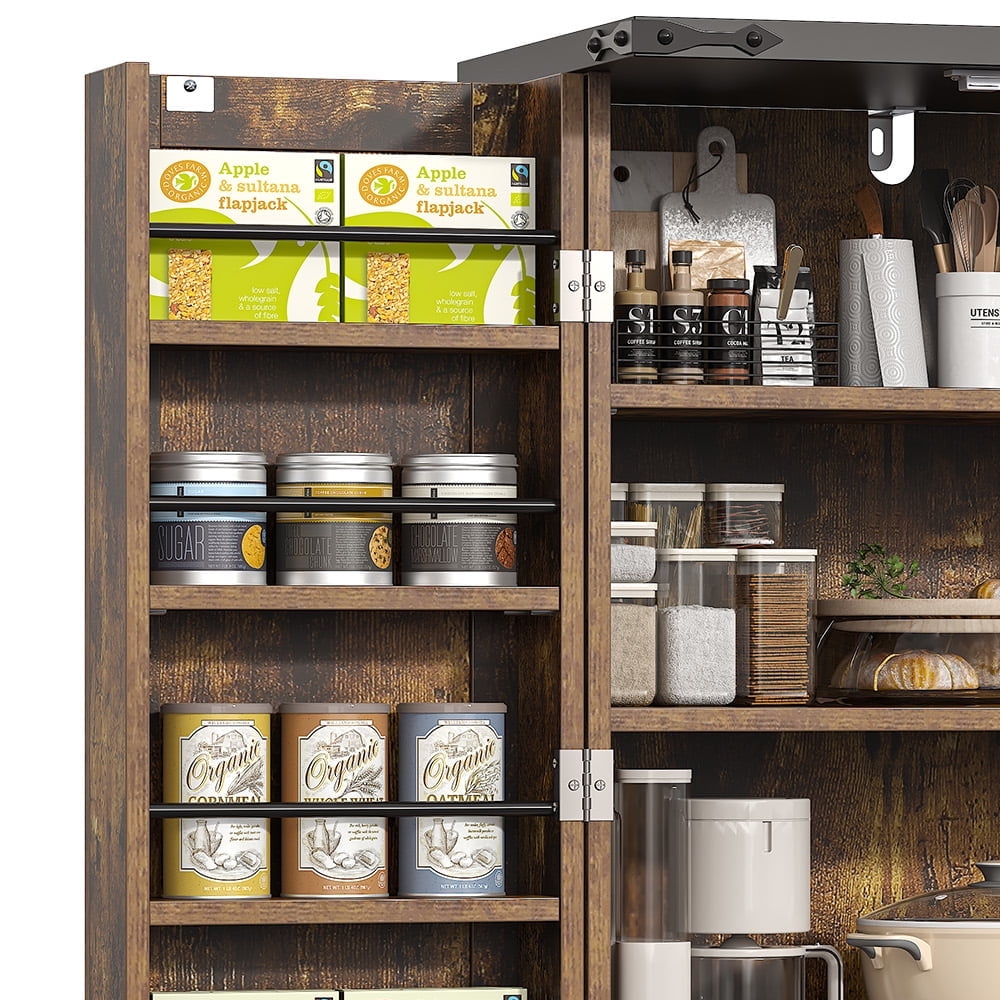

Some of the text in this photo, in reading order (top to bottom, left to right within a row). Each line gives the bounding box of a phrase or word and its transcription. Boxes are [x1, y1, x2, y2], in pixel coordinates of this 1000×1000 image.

[219, 162, 269, 178] Apple
[416, 166, 466, 182] Apple
[219, 179, 300, 193] & sultana
[417, 184, 497, 197] & sultana
[218, 197, 287, 213] flapjack
[416, 201, 484, 217] flapjack
[627, 307, 653, 333] S1
[158, 525, 204, 560] SUGAR
[187, 739, 260, 792] Organic
[305, 739, 379, 792] Organic
[423, 739, 495, 791] Organic
